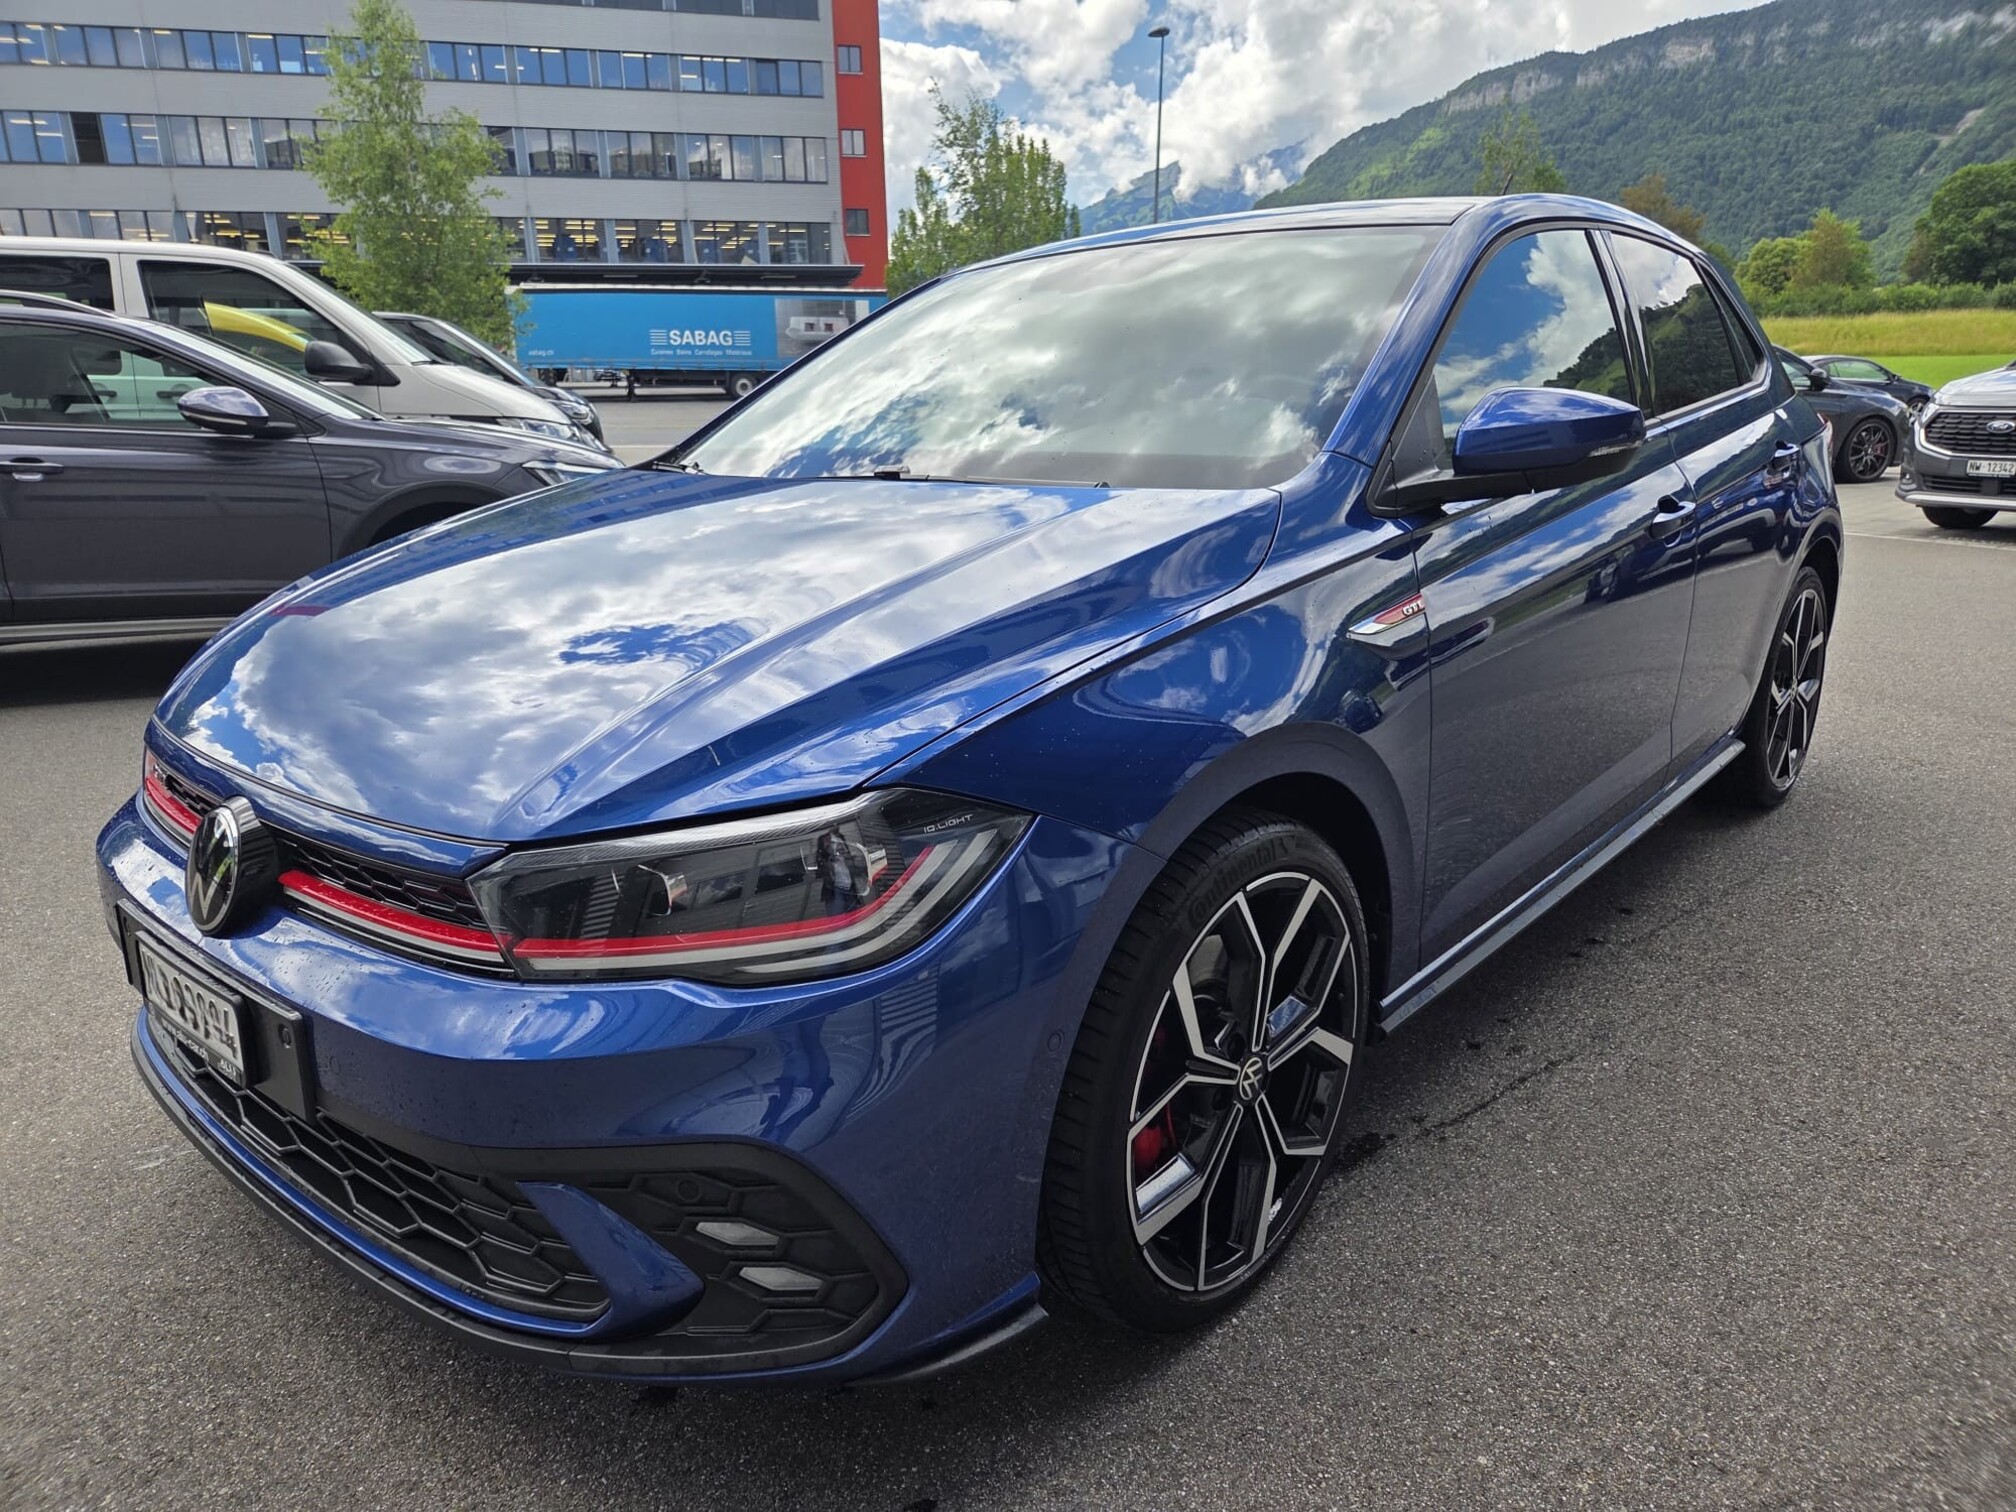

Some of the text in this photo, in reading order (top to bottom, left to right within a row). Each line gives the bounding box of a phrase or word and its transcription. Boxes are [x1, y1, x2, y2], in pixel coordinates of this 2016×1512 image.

[669, 330, 733, 346] SABAG
[1969, 462, 2014, 473] NW 12342
[1402, 601, 1423, 615] GTI
[923, 813, 974, 834] IQ.LIGHT
